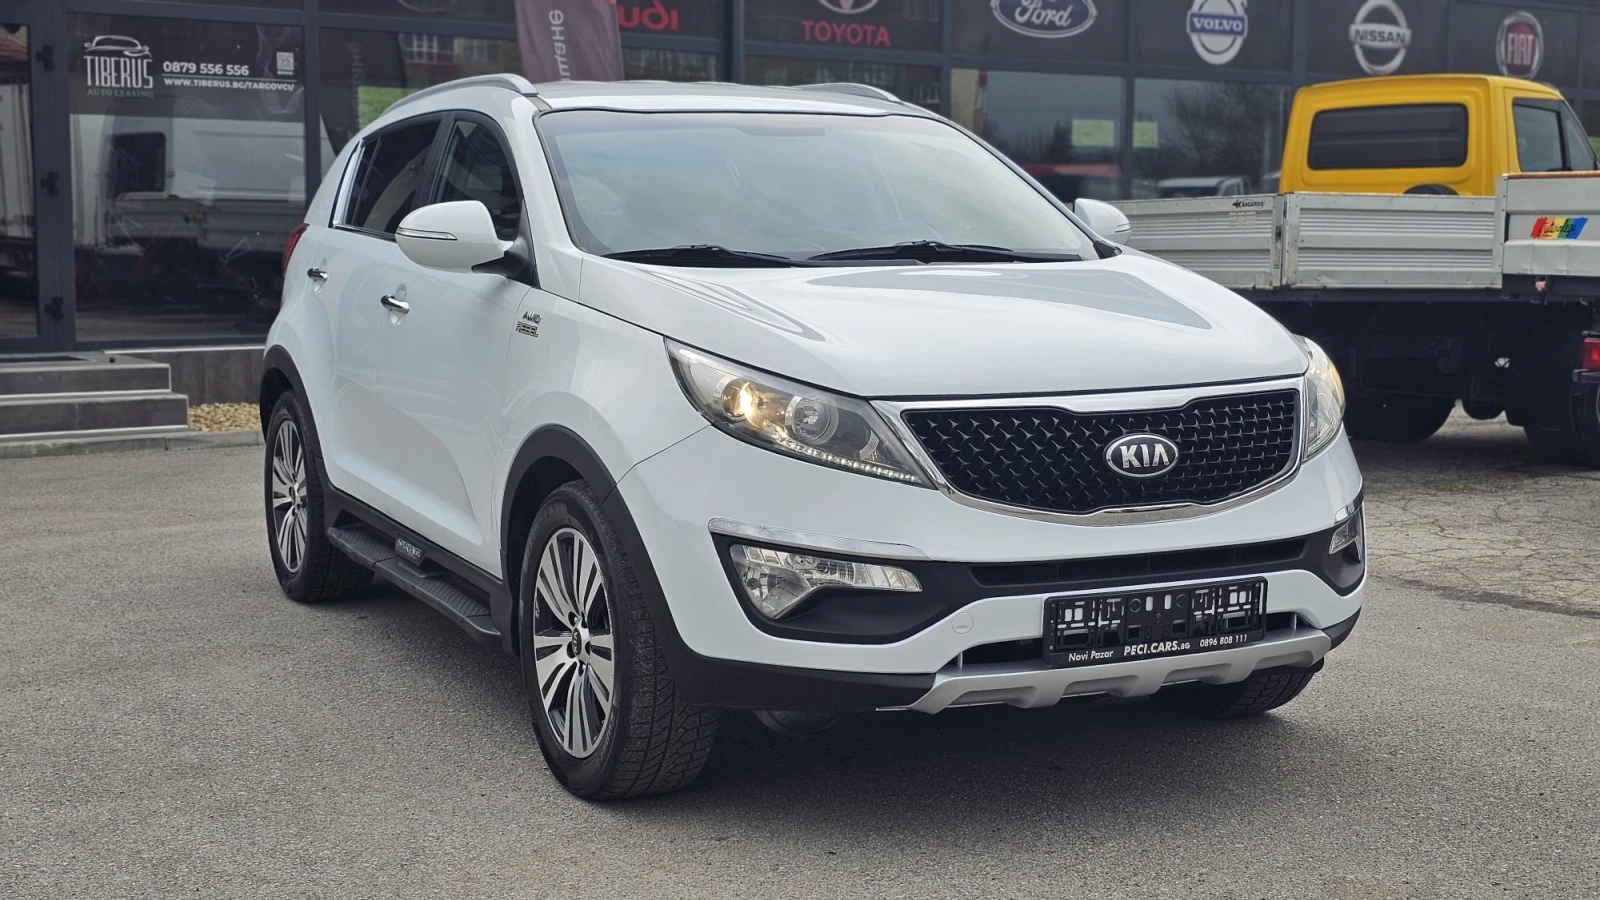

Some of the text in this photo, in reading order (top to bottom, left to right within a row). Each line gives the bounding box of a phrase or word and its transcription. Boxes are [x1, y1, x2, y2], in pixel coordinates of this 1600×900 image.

[617, 0, 678, 31] udi
[1015, 0, 1072, 27] Ford
[1192, 16, 1243, 32] VOLVO
[801, 19, 891, 47] TOYOTA
[1354, 28, 1406, 44] NISSAN
[1507, 32, 1535, 66] FIAT
[83, 55, 154, 89] TIBERUS
[163, 61, 250, 76] 0879 556 556
[87, 88, 154, 98] AUTO LEASING
[1120, 443, 1170, 468] KIA
[1068, 651, 1089, 662] Novi
[1090, 650, 1114, 660] Pazar
[1200, 637, 1218, 647] 0896
[1219, 635, 1233, 645] 808
[1235, 633, 1248, 643] 111
